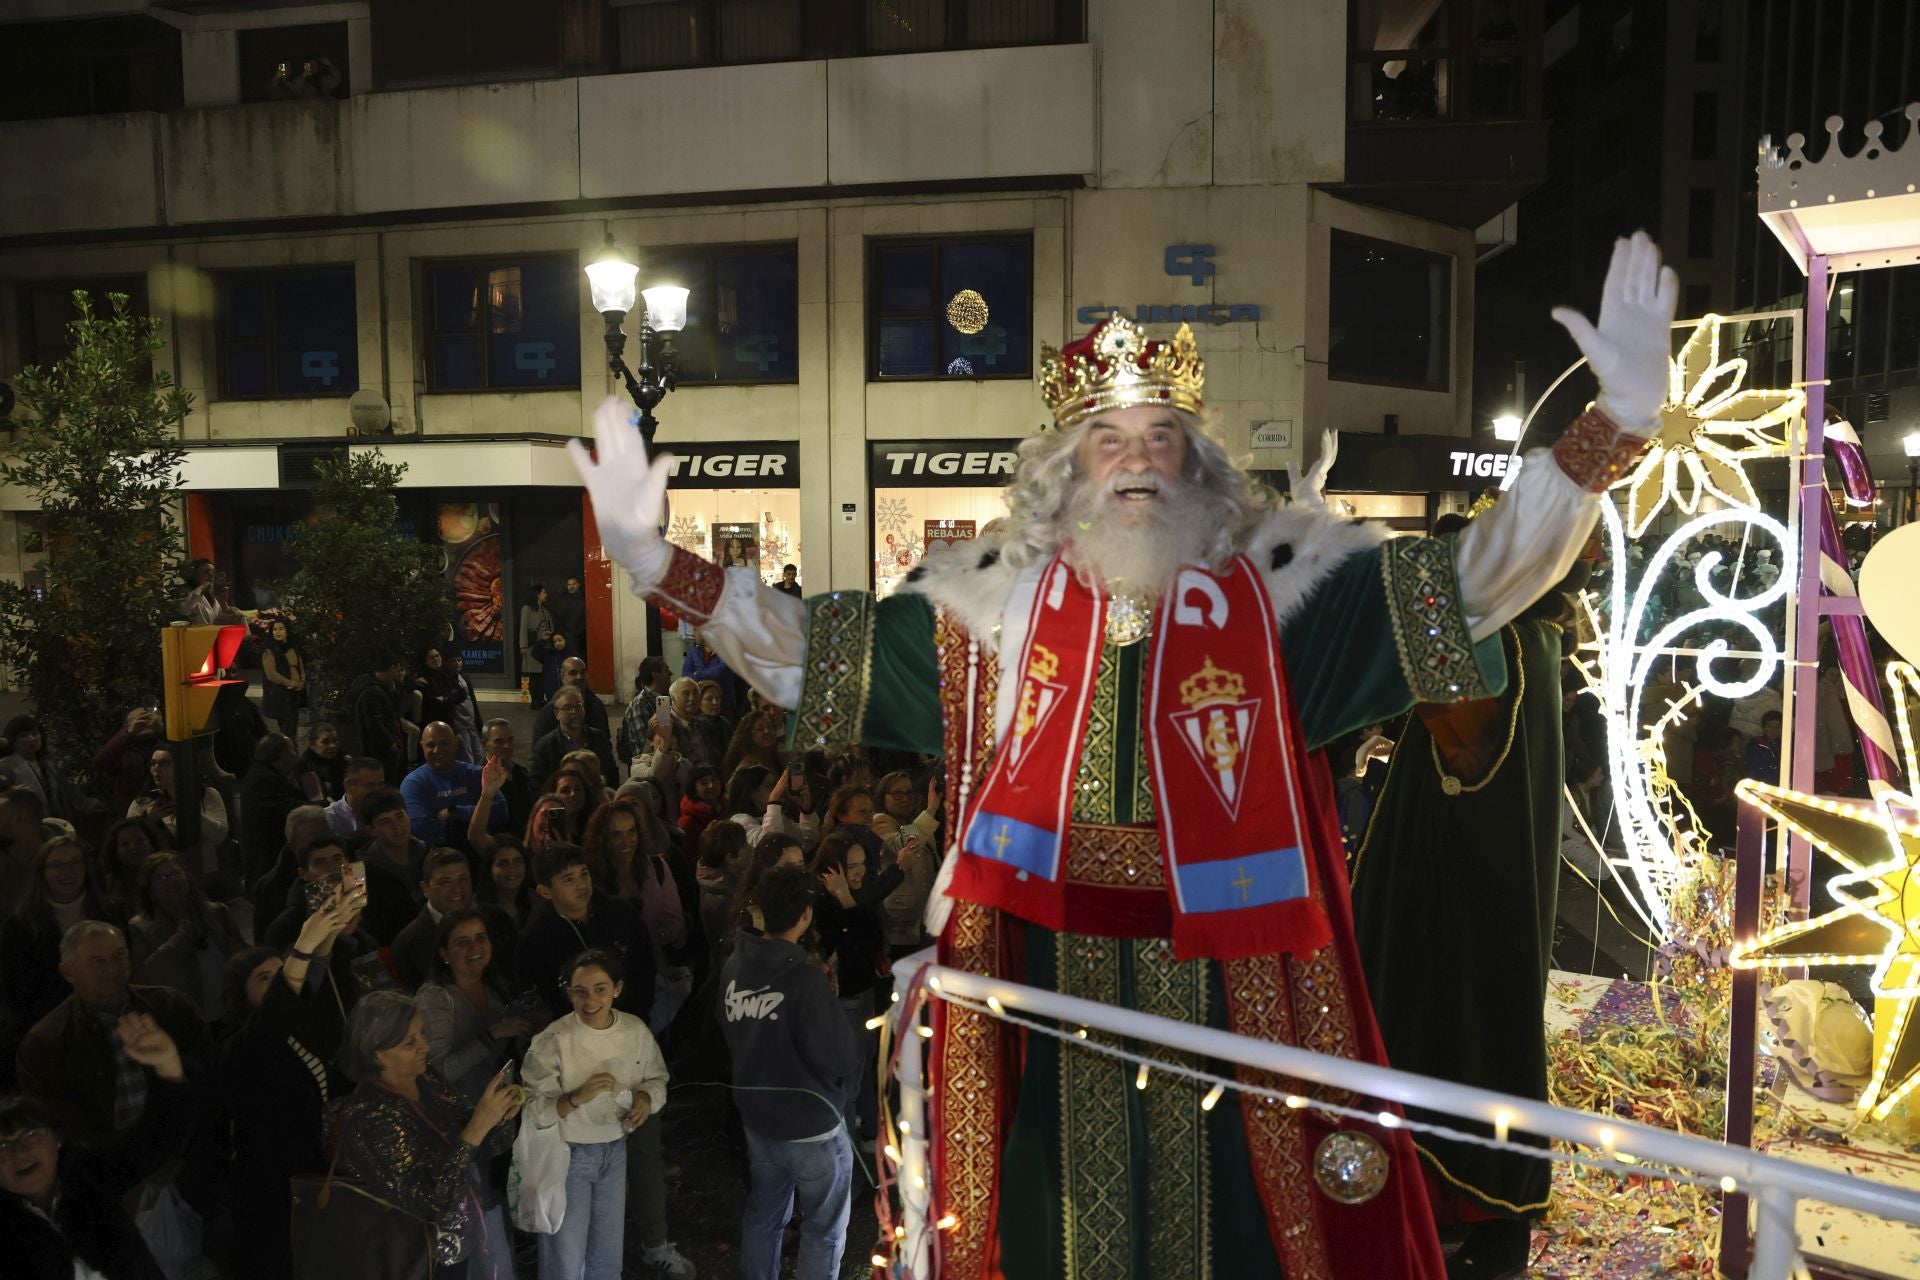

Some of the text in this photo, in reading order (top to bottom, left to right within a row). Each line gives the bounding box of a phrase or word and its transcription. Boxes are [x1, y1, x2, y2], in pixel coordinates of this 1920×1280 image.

[1258, 433, 1287, 442] CORRIDA
[669, 455, 787, 477] TIGER
[886, 452, 1018, 475] TIGER
[927, 529, 973, 538] REBAJAS
